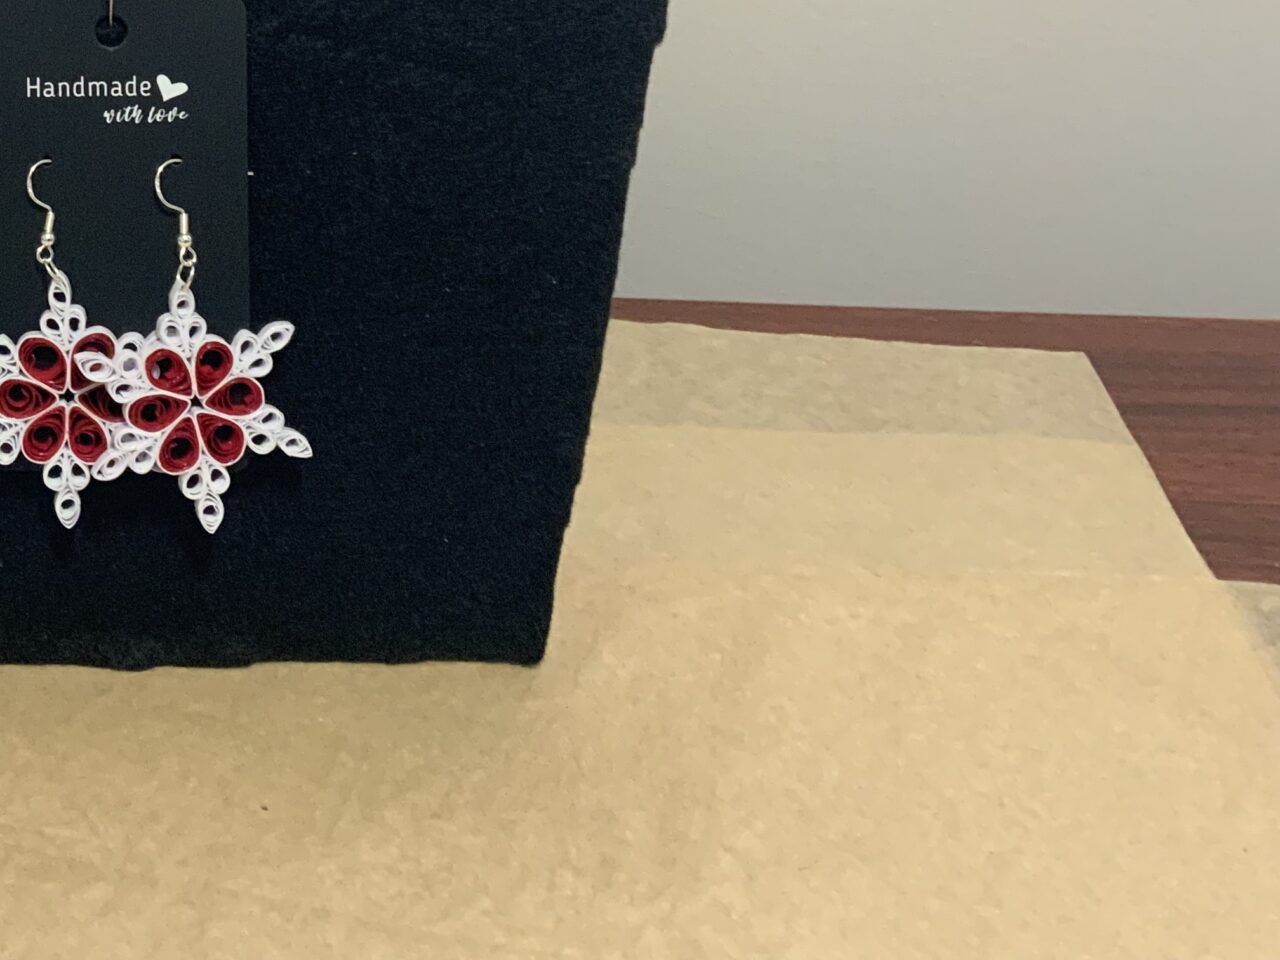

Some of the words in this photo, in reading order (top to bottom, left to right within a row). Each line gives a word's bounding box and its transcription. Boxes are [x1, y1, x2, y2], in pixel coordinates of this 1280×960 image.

[26, 75, 152, 98] Handmade
[103, 104, 143, 124] with
[147, 106, 189, 124] love
